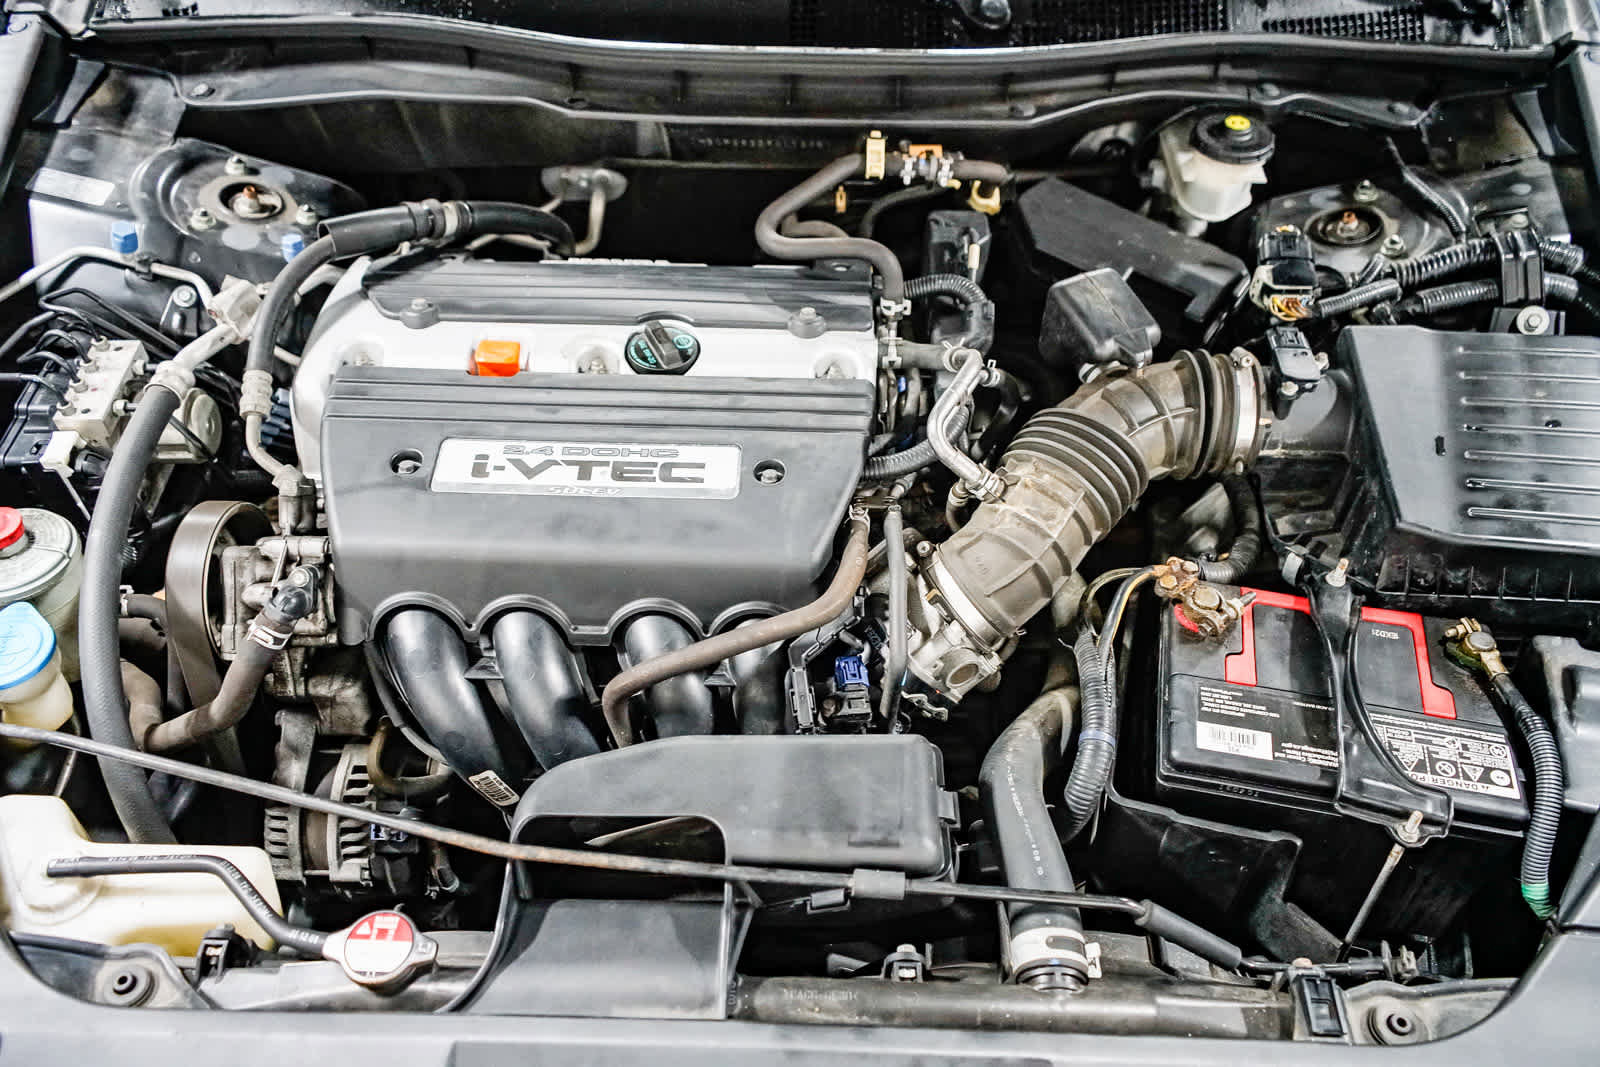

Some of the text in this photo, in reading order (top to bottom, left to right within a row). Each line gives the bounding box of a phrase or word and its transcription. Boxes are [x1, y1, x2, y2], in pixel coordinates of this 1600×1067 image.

[503, 445, 680, 457] 2.4 DOHC
[471, 454, 706, 483] i-VTEC
[1431, 775, 1479, 791] DANGER
